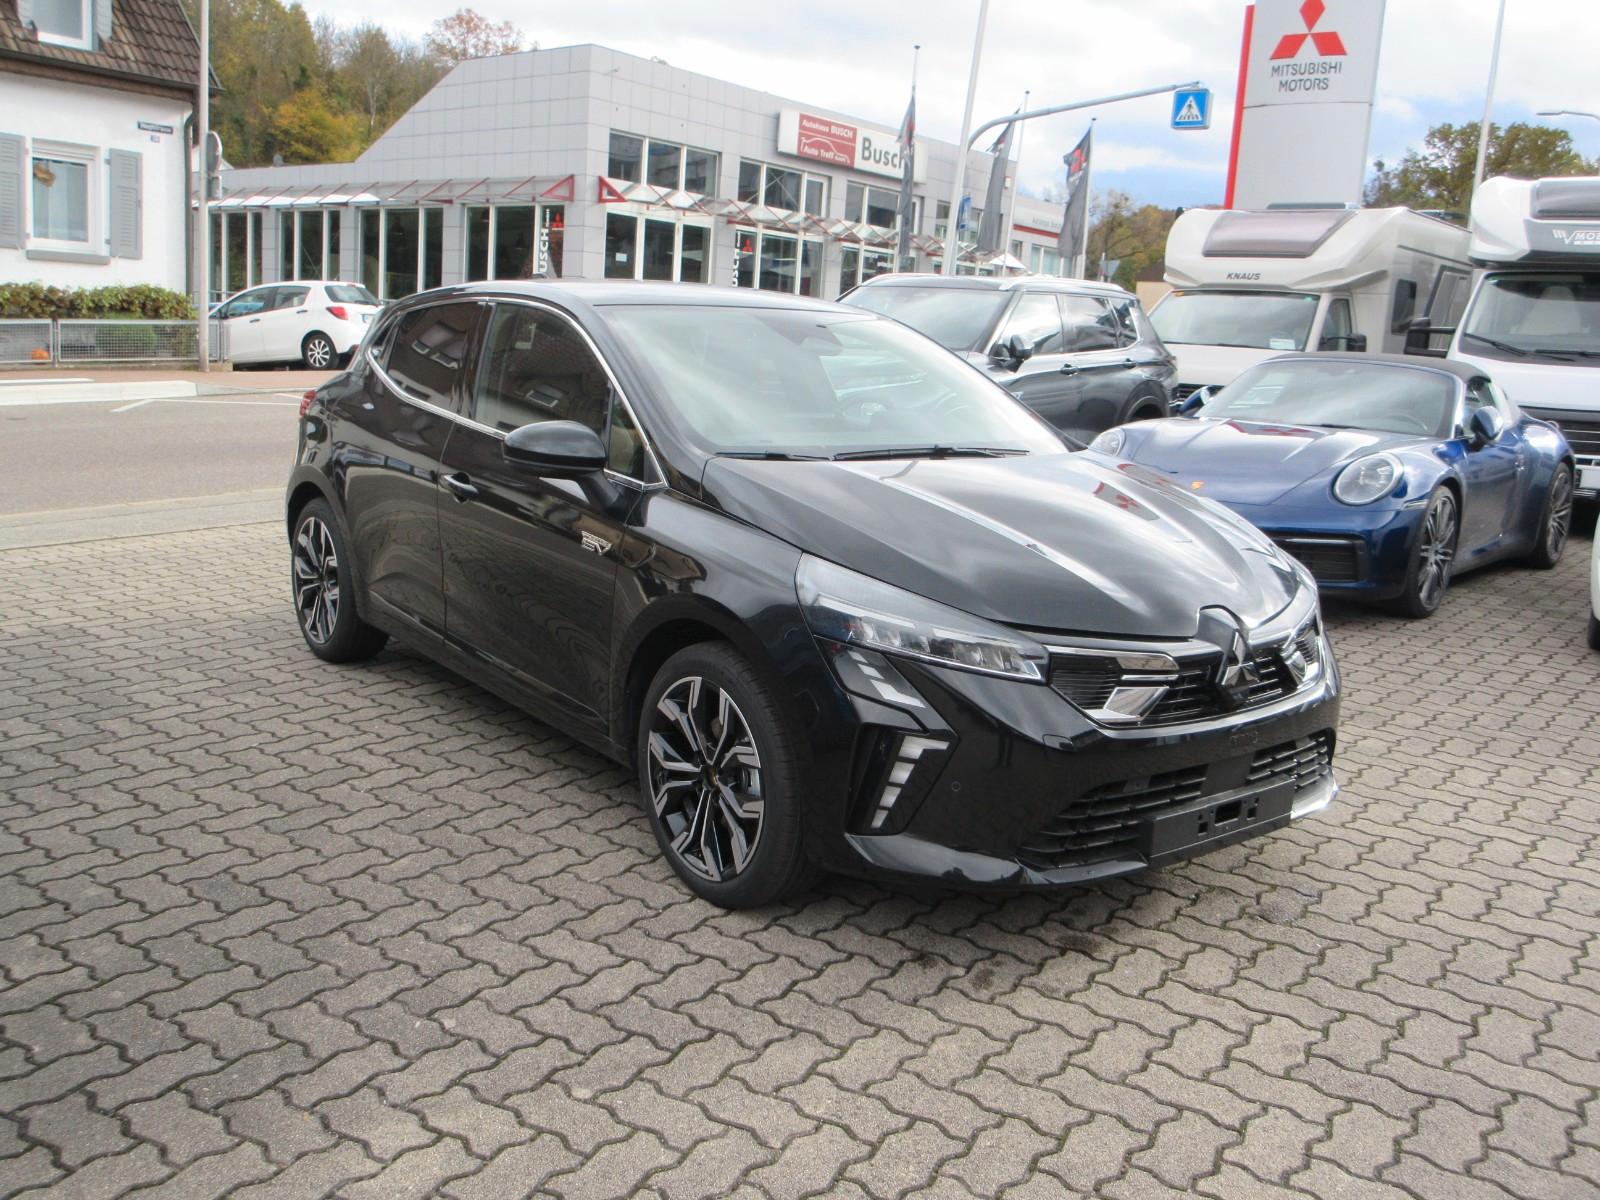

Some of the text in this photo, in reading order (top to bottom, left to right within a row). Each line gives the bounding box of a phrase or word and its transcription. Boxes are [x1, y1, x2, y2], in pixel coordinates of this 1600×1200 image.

[1271, 61, 1342, 77] MITSUBISHI
[1278, 78, 1329, 92] MOTORS
[831, 125, 853, 138] BUSCH
[1226, 272, 1261, 281] KNAUS
